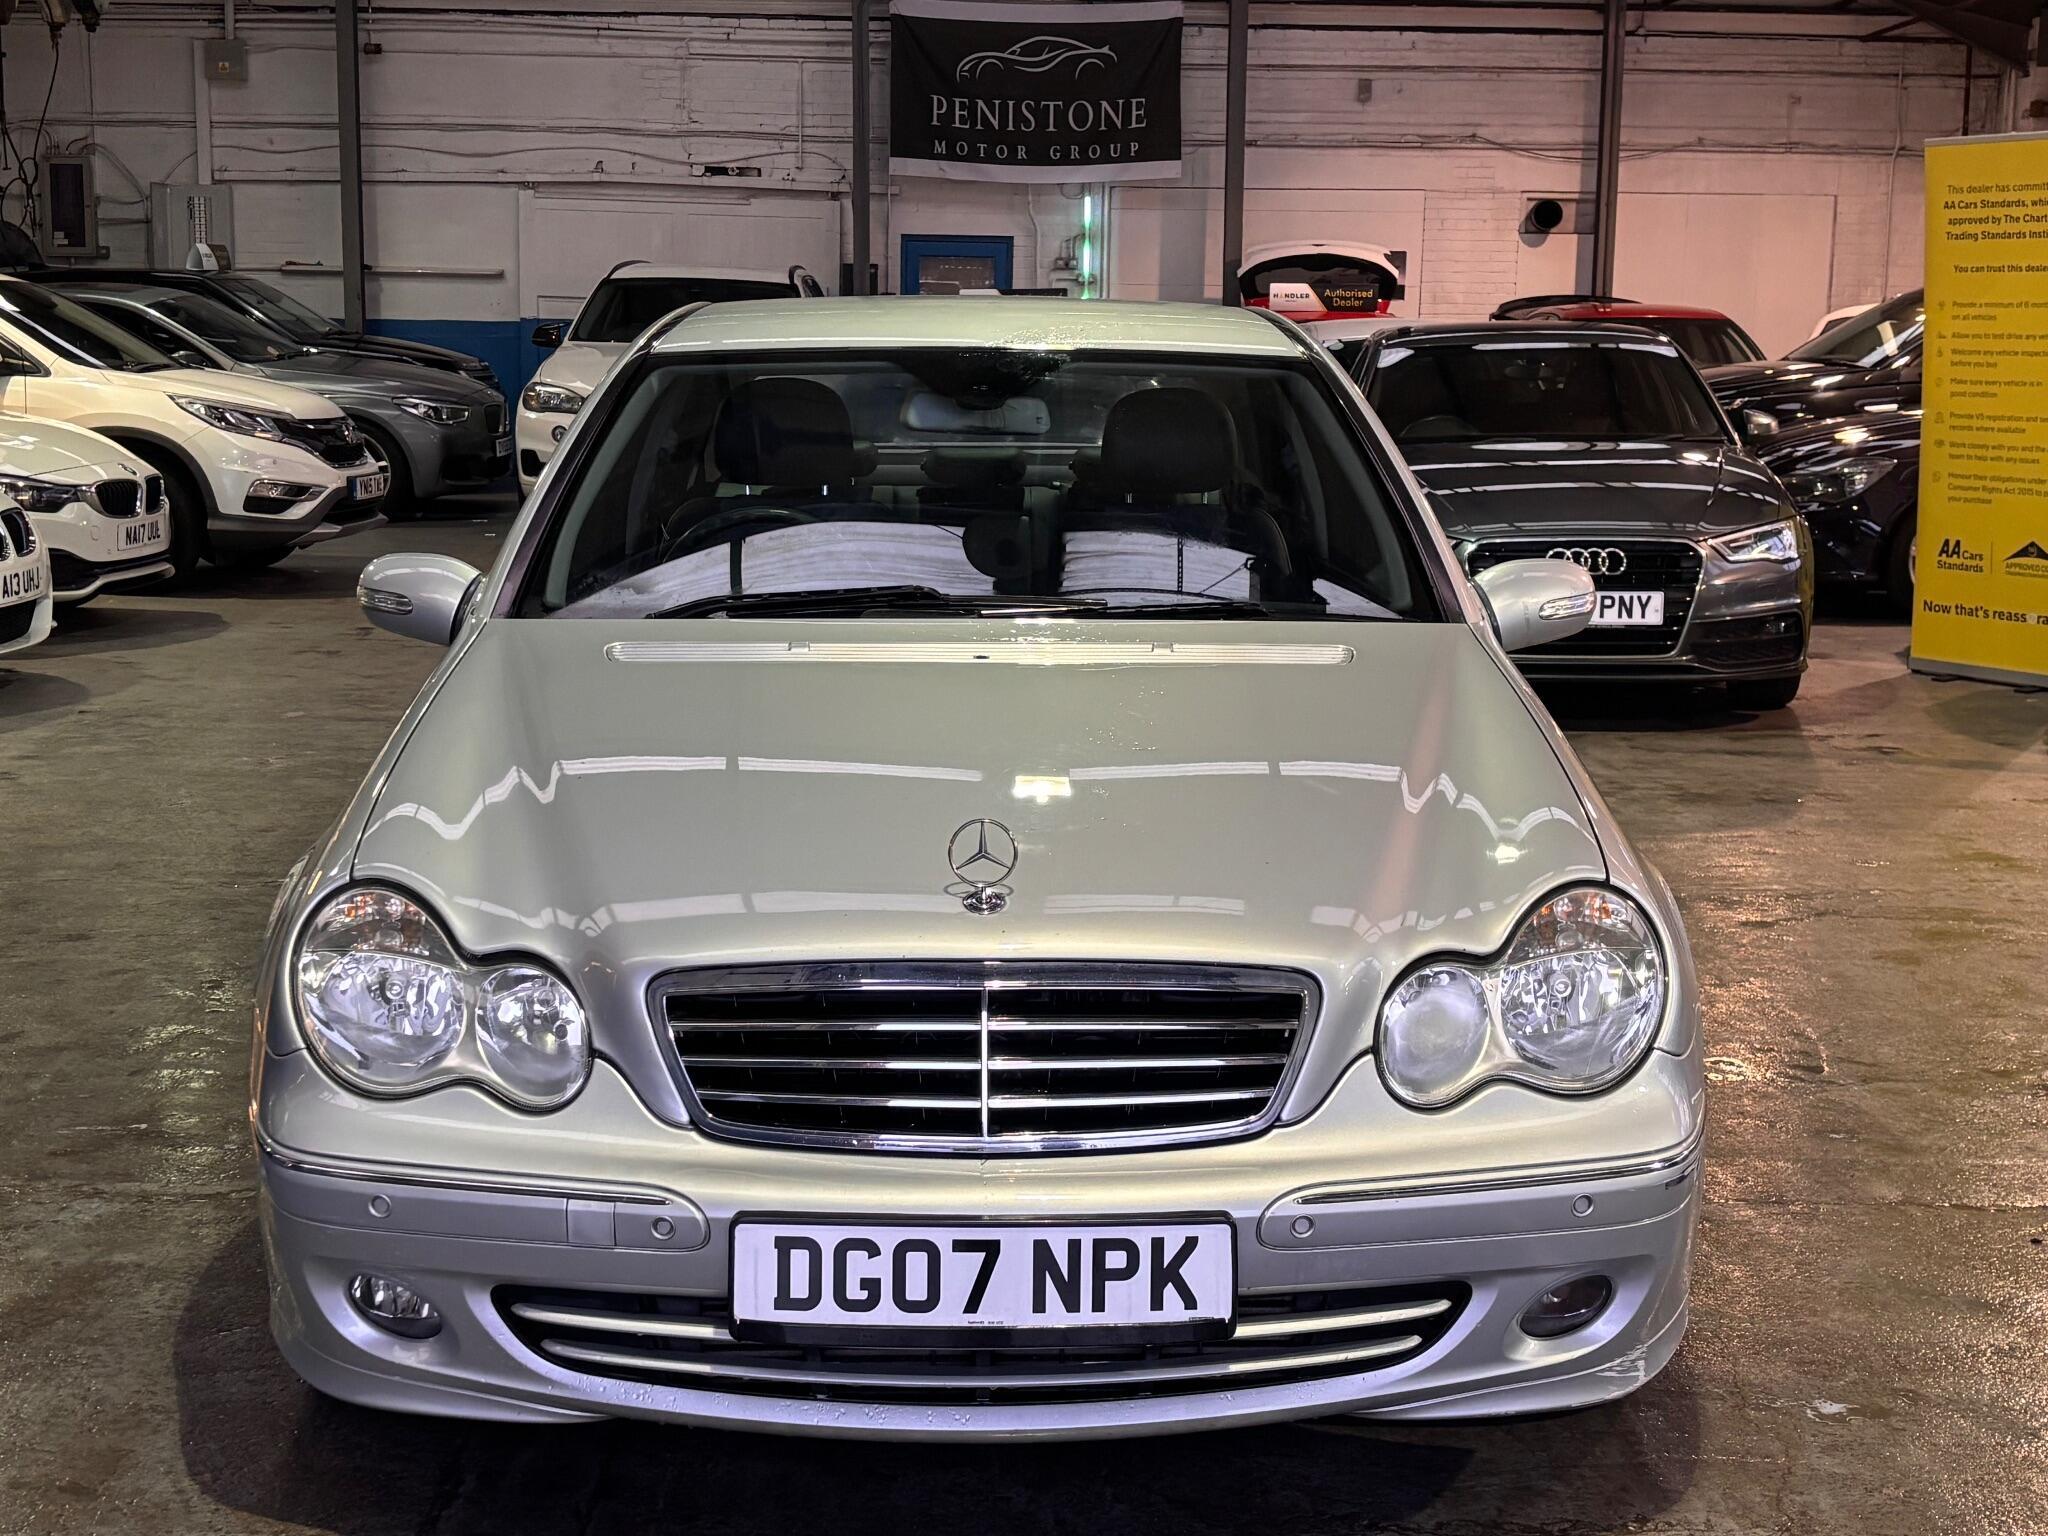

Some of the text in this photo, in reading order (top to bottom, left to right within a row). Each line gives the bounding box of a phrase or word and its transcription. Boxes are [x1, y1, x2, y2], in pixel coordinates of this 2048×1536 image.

[929, 94, 1147, 132] PENISTONE
[934, 139, 1139, 160] MOTOR GROUP
[1948, 184, 1964, 194] This
[1966, 184, 1993, 194] dealer
[1996, 183, 2011, 193] has
[1944, 201, 1956, 210] AA
[1958, 200, 1978, 209] Cars
[1980, 199, 2028, 209] Standards,
[1948, 216, 1990, 226] approved
[1992, 216, 2002, 225] by
[2004, 214, 2020, 223] The
[1946, 231, 1978, 241] Trading
[1981, 230, 2026, 240] Standards
[1954, 264, 1968, 273] You
[1987, 264, 2005, 273] trust
[2007, 264, 2023, 272] this
[1324, 289, 1373, 299] Authorised
[1333, 298, 1363, 307] Dealer
[125, 524, 146, 546] NA17
[1938, 538, 1984, 561] AA Cars
[1937, 560, 1984, 573] Standards
[22, 566, 40, 594] UHJ
[1600, 595, 1652, 619] PNY
[1923, 600, 1952, 614] Now
[1954, 604, 1990, 619] that's
[774, 1236, 1200, 1314] DG07 NPK
